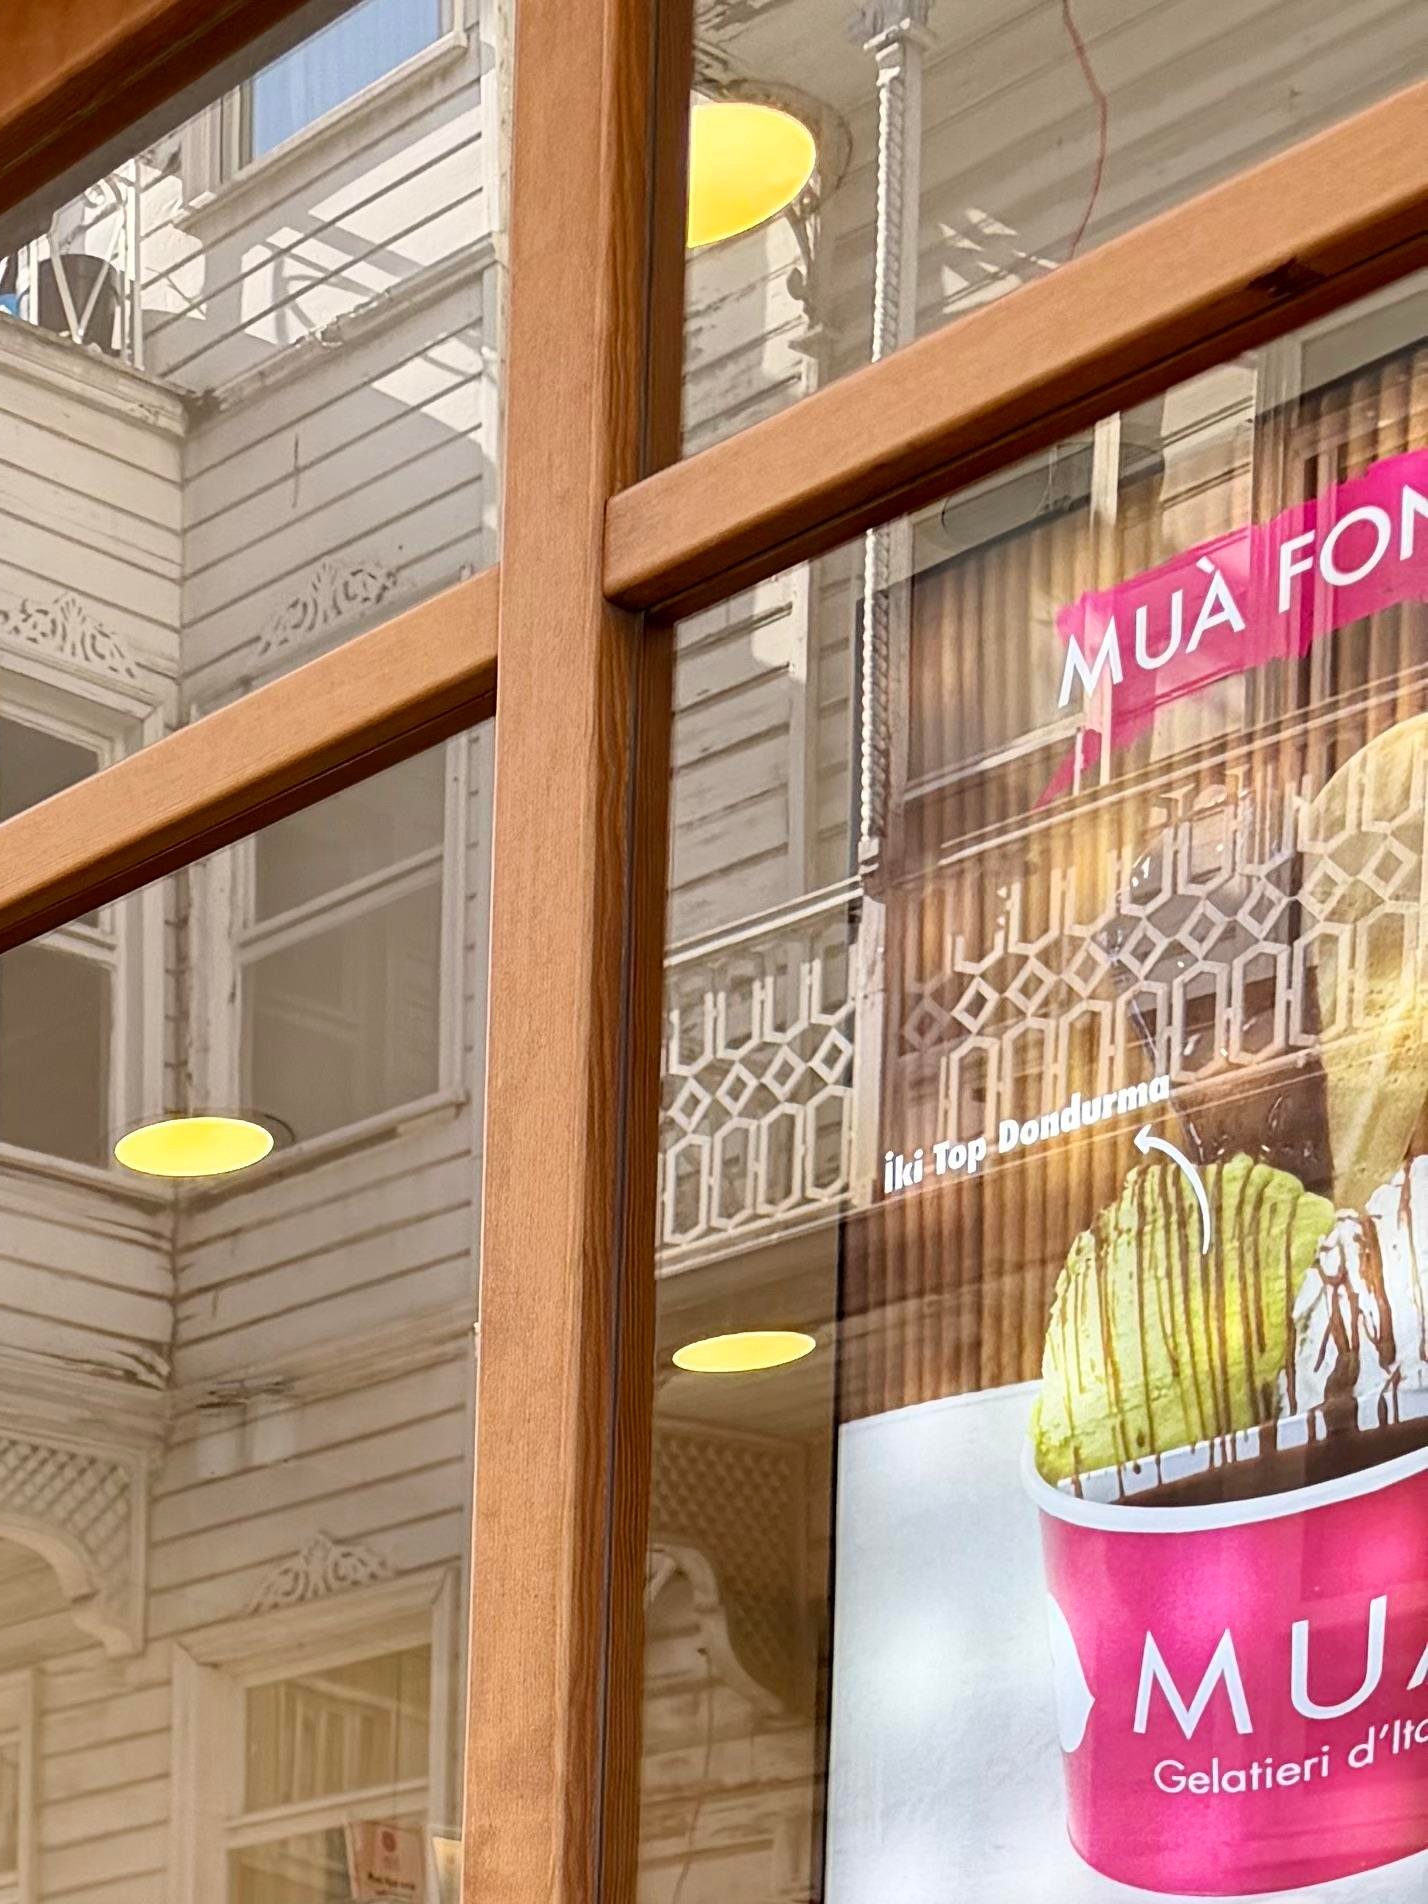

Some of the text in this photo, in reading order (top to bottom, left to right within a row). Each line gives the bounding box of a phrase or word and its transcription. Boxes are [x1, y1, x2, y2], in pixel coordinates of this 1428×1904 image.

[1058, 555, 1246, 709] MUÀ
[932, 1136, 987, 1175] Top
[998, 1074, 1170, 1154] Dondurma
[1133, 1594, 1428, 1740] MU
[1153, 1744, 1330, 1794] Gelatieri
